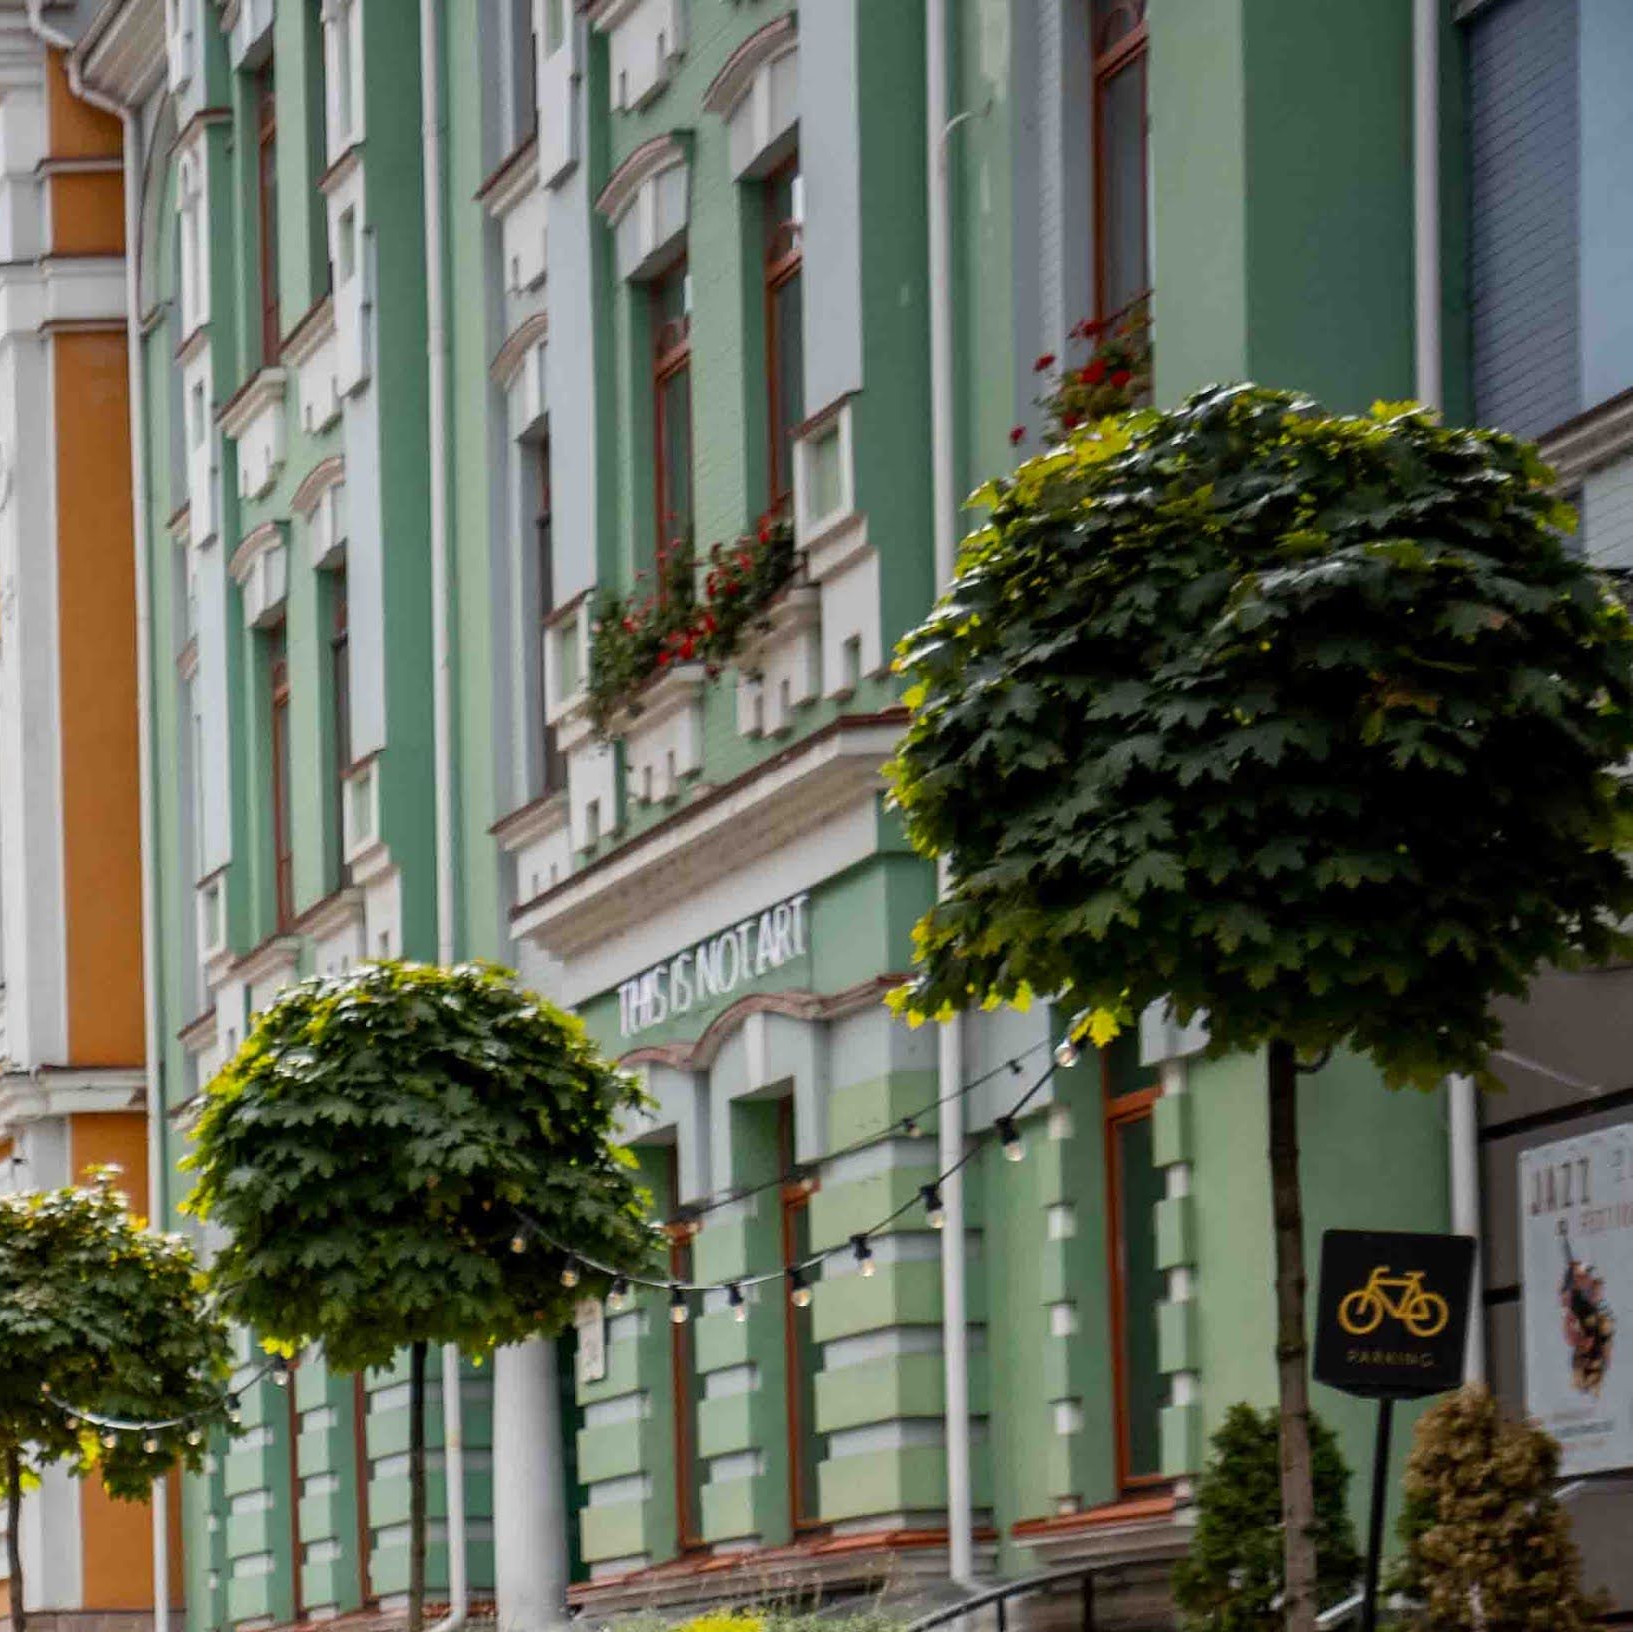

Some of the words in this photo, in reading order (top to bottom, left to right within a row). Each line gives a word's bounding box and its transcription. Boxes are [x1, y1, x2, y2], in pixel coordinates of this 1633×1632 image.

[618, 965, 667, 1037] THIS
[671, 953, 693, 1013] IS
[695, 921, 757, 997] NOT
[755, 895, 808, 975] ART
